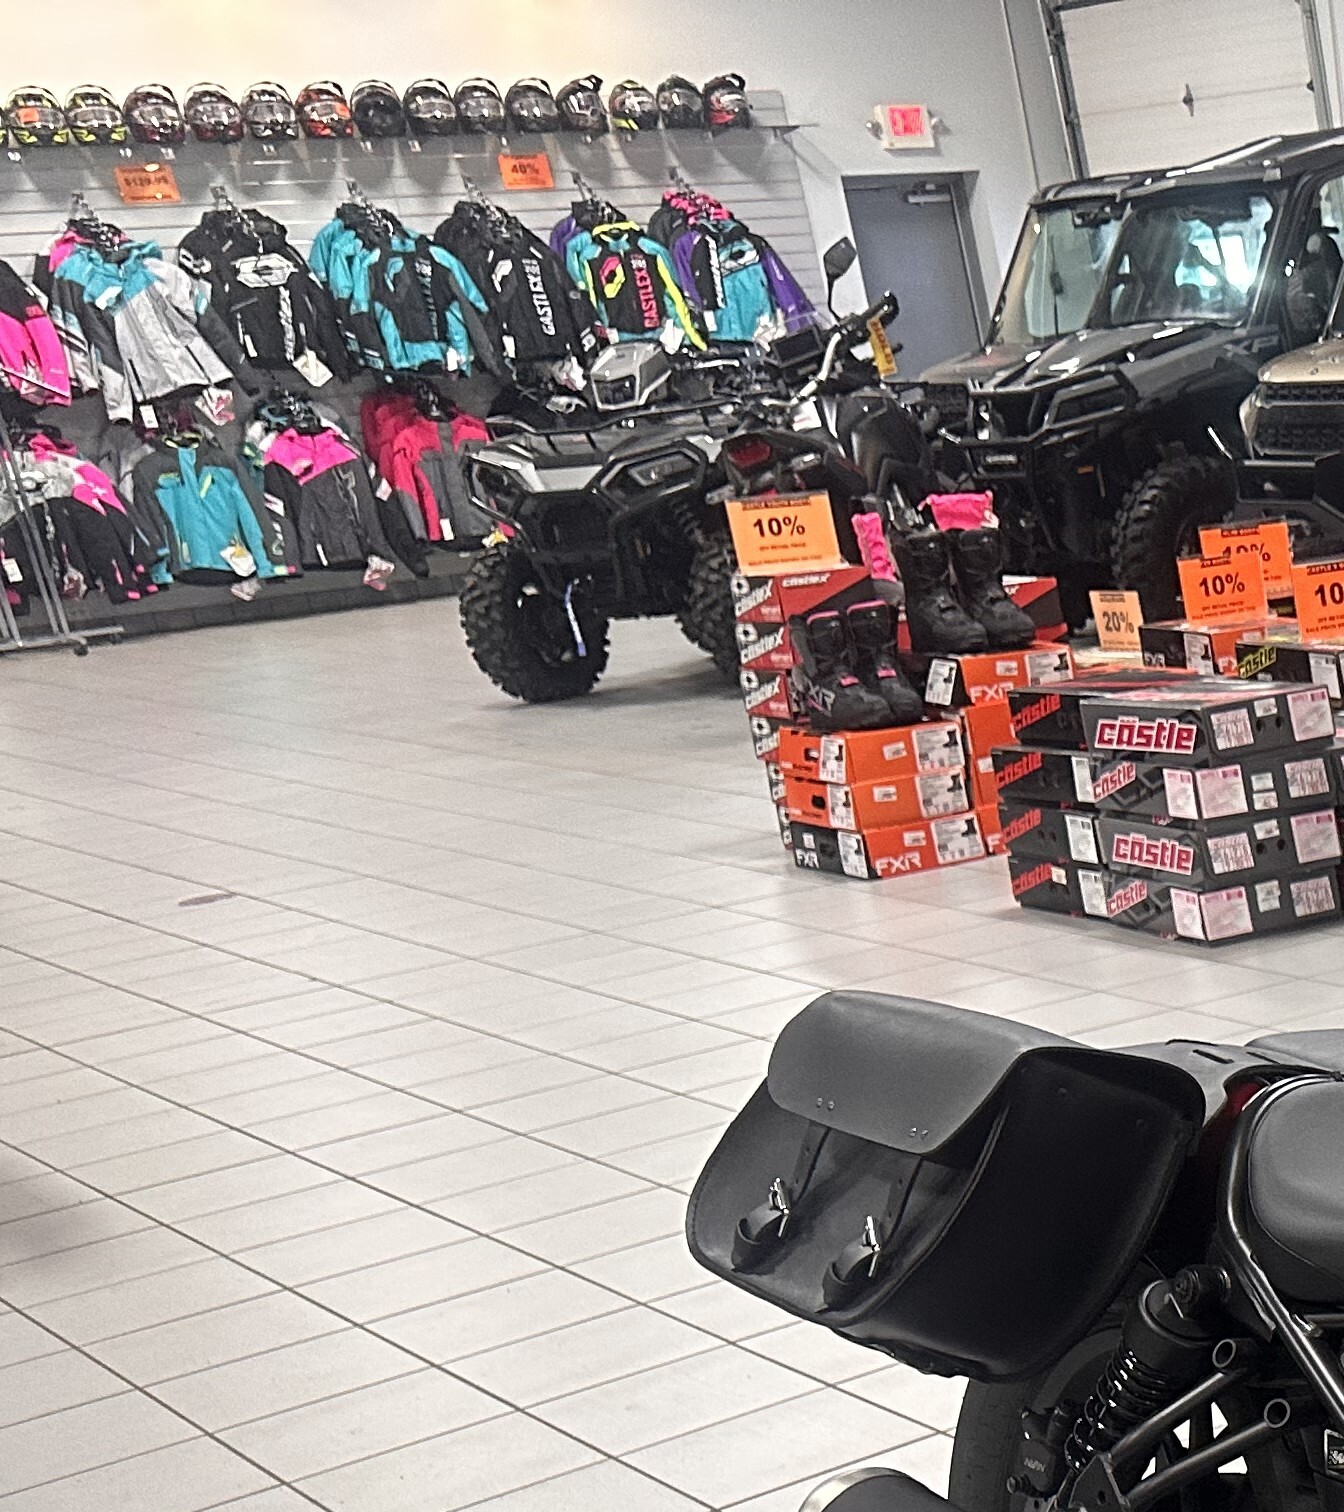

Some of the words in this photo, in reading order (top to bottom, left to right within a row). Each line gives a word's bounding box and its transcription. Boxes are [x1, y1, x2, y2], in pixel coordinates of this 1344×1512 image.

[753, 515, 806, 538] 10%
[1199, 572, 1246, 598] 10%
[1102, 610, 1135, 635] 20%
[1011, 694, 1062, 732] castle
[1095, 717, 1197, 754] castle
[1092, 762, 1136, 801] castle
[796, 850, 820, 868] FXR
[875, 852, 922, 877] FXR
[1113, 833, 1194, 876] castle
